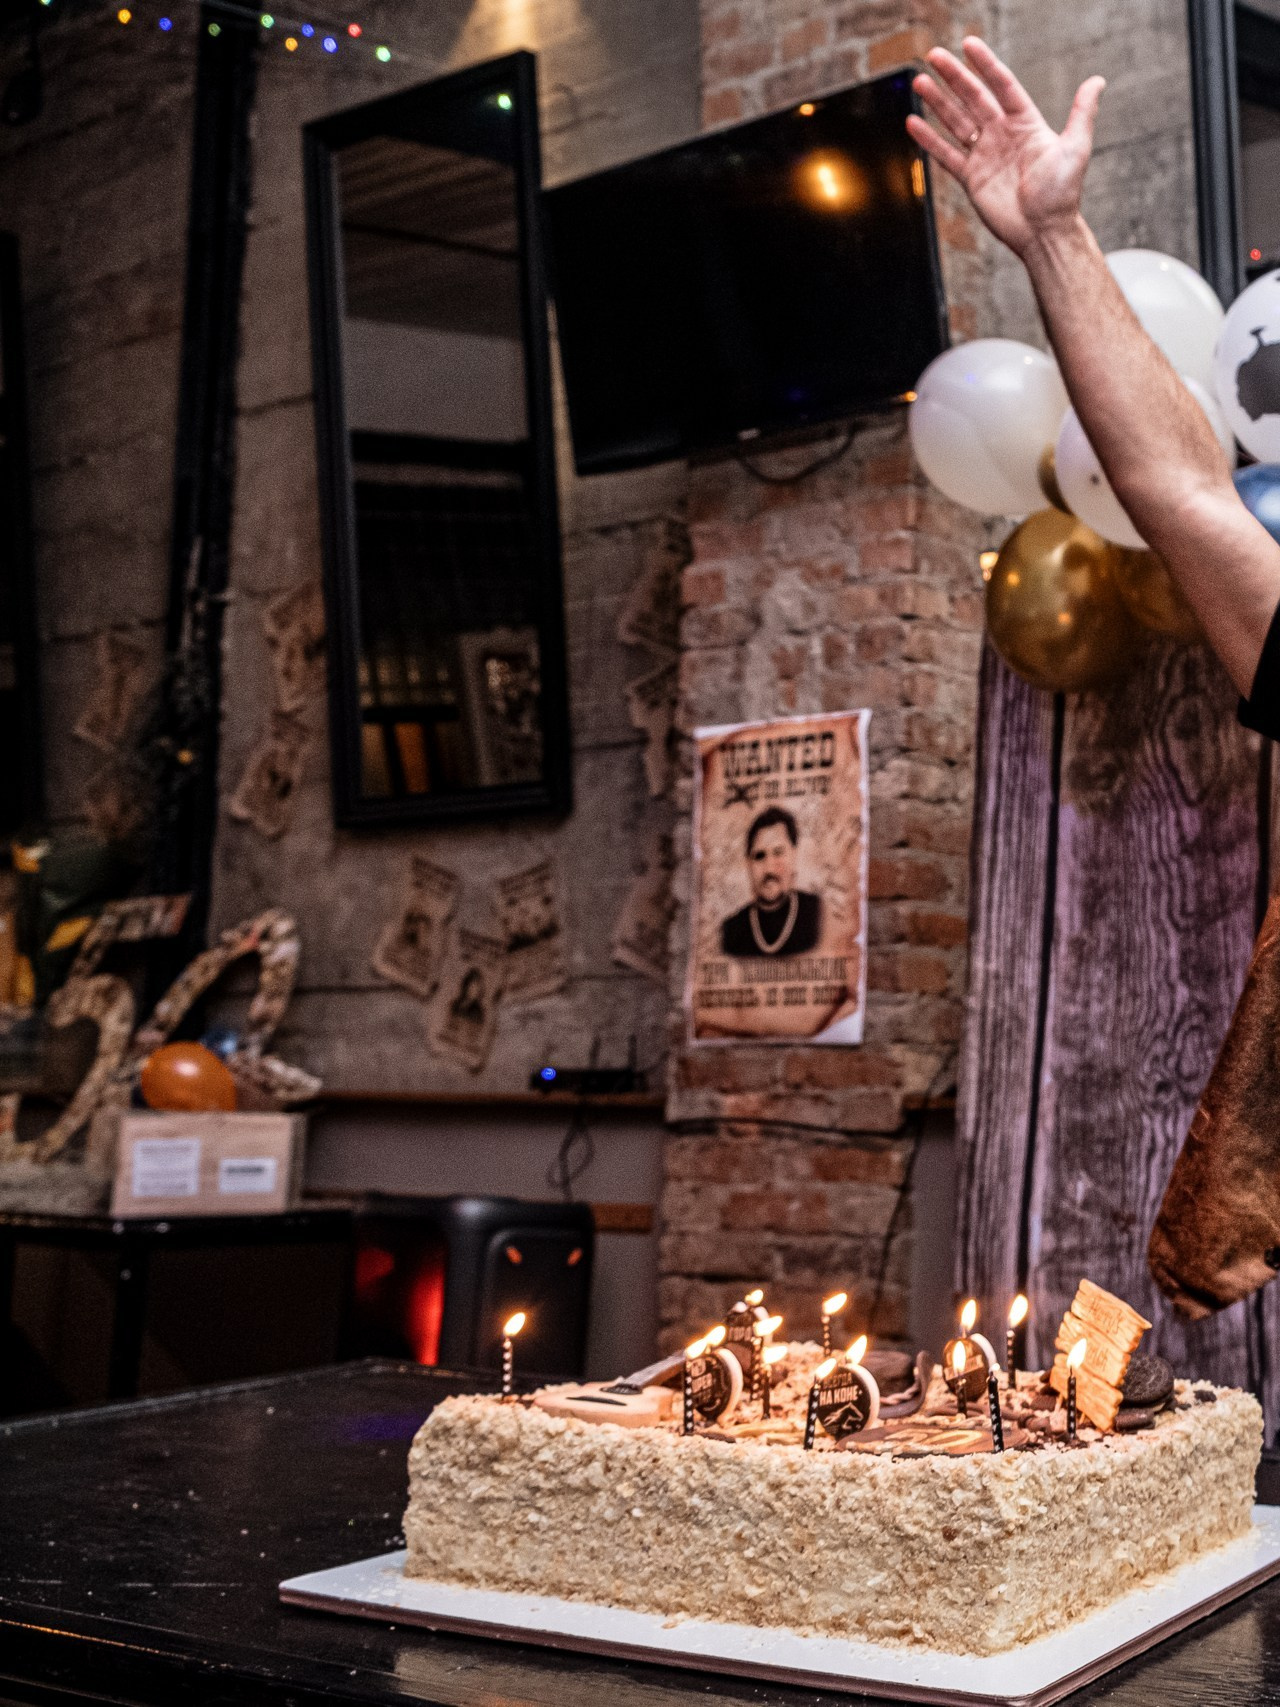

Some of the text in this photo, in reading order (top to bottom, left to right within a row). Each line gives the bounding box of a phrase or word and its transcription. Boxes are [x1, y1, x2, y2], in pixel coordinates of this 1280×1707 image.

[719, 731, 835, 779] WANTED
[819, 1385, 860, 1407] НА КОНЕ
